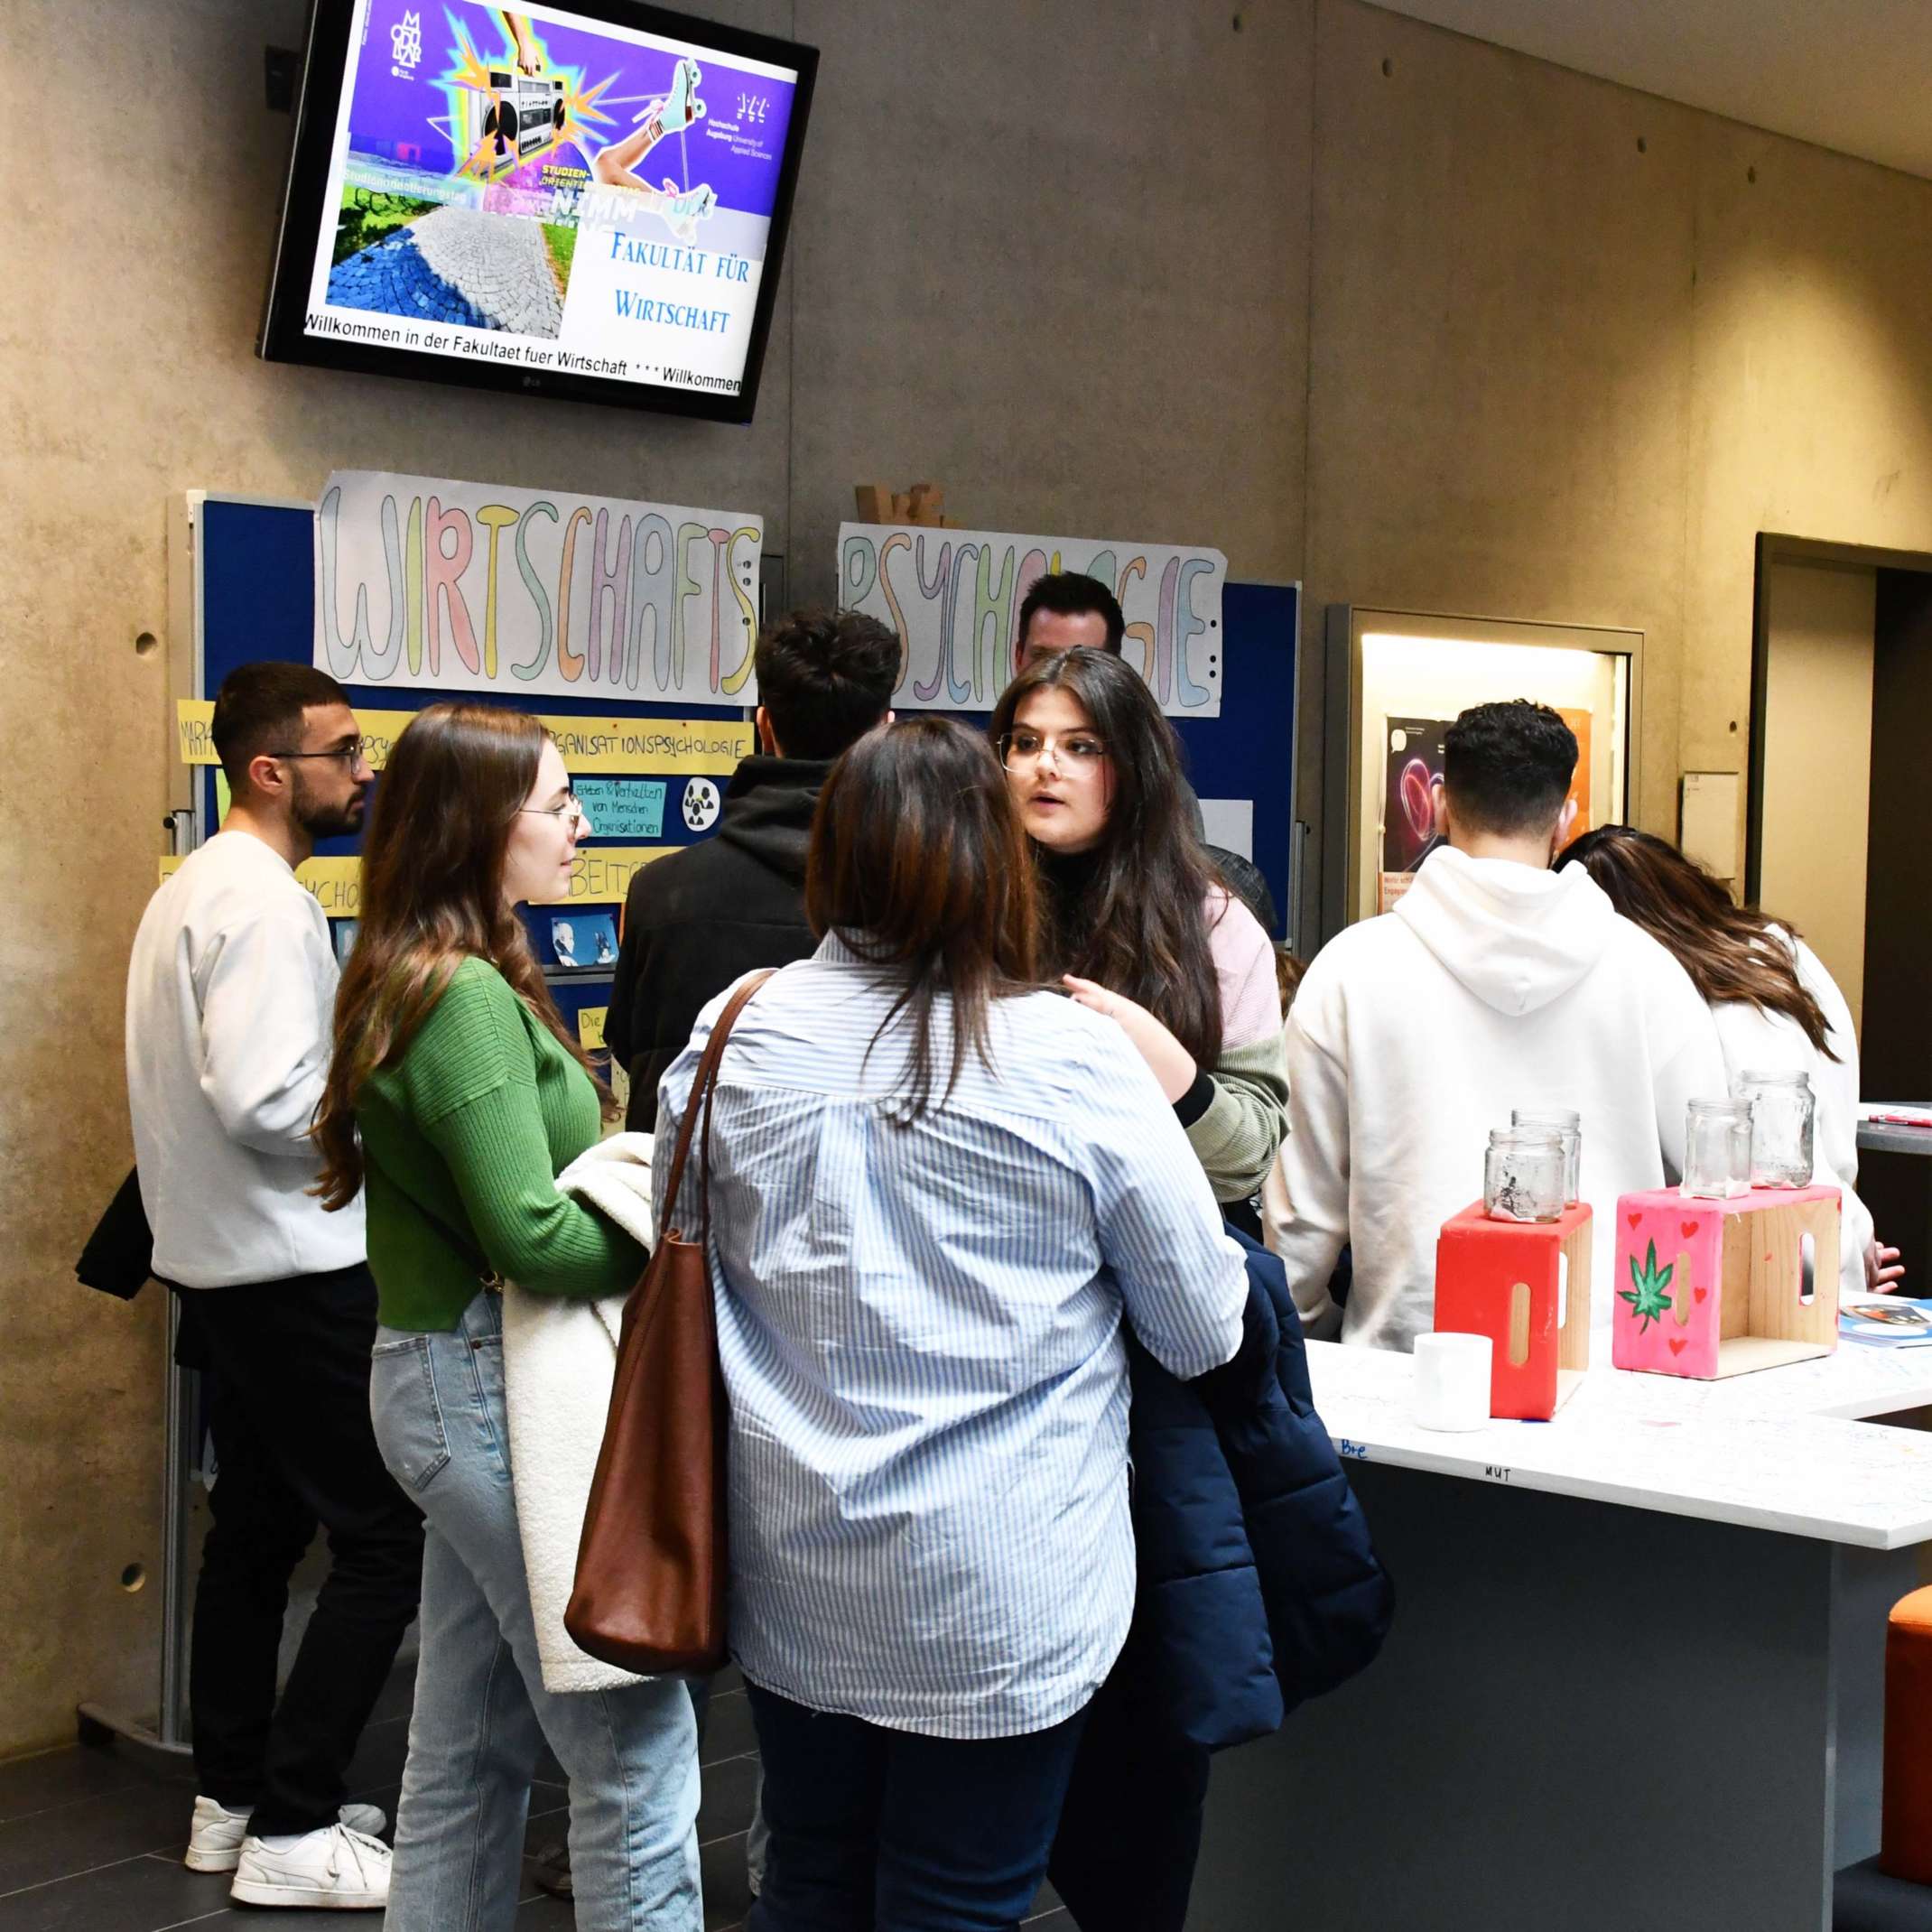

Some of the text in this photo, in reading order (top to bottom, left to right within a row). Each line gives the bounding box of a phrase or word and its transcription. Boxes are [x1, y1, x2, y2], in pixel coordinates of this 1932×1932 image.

[542, 163, 591, 179] STUDIEN-
[304, 313, 743, 393] Willkommen in der Fakultaet fuer Wirtschaft Willkommen
[320, 485, 760, 696] WIRTSCHAFTS
[592, 802, 608, 813] von
[581, 1012, 600, 1029] Die
[1485, 1466, 1511, 1482] MUT
